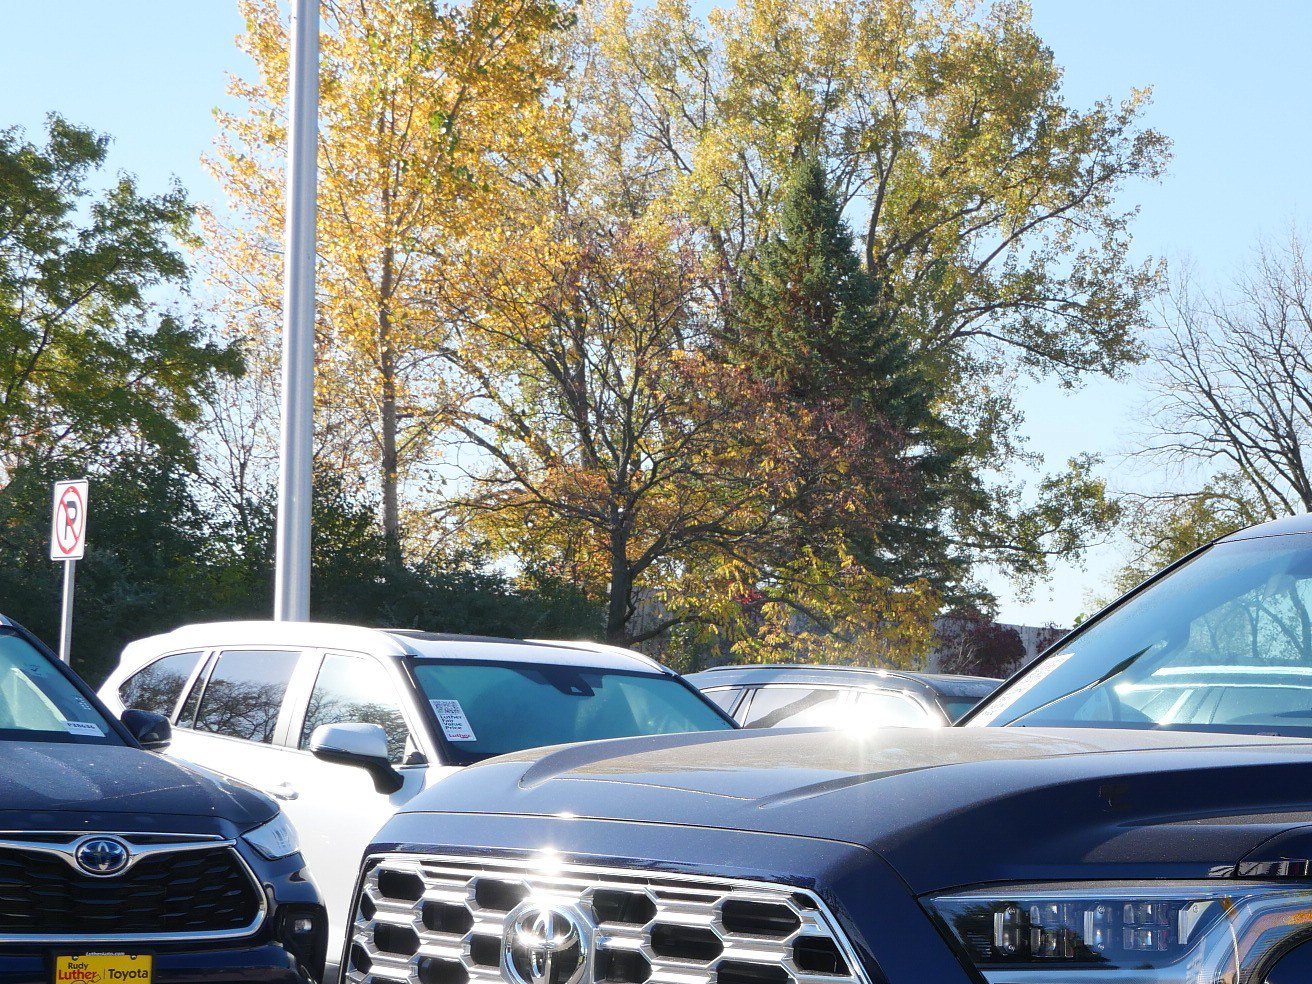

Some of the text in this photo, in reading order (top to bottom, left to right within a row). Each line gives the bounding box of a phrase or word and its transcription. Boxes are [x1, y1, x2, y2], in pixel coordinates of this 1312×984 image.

[67, 962, 89, 970] Rudy
[58, 968, 149, 981] Luther Toyota
